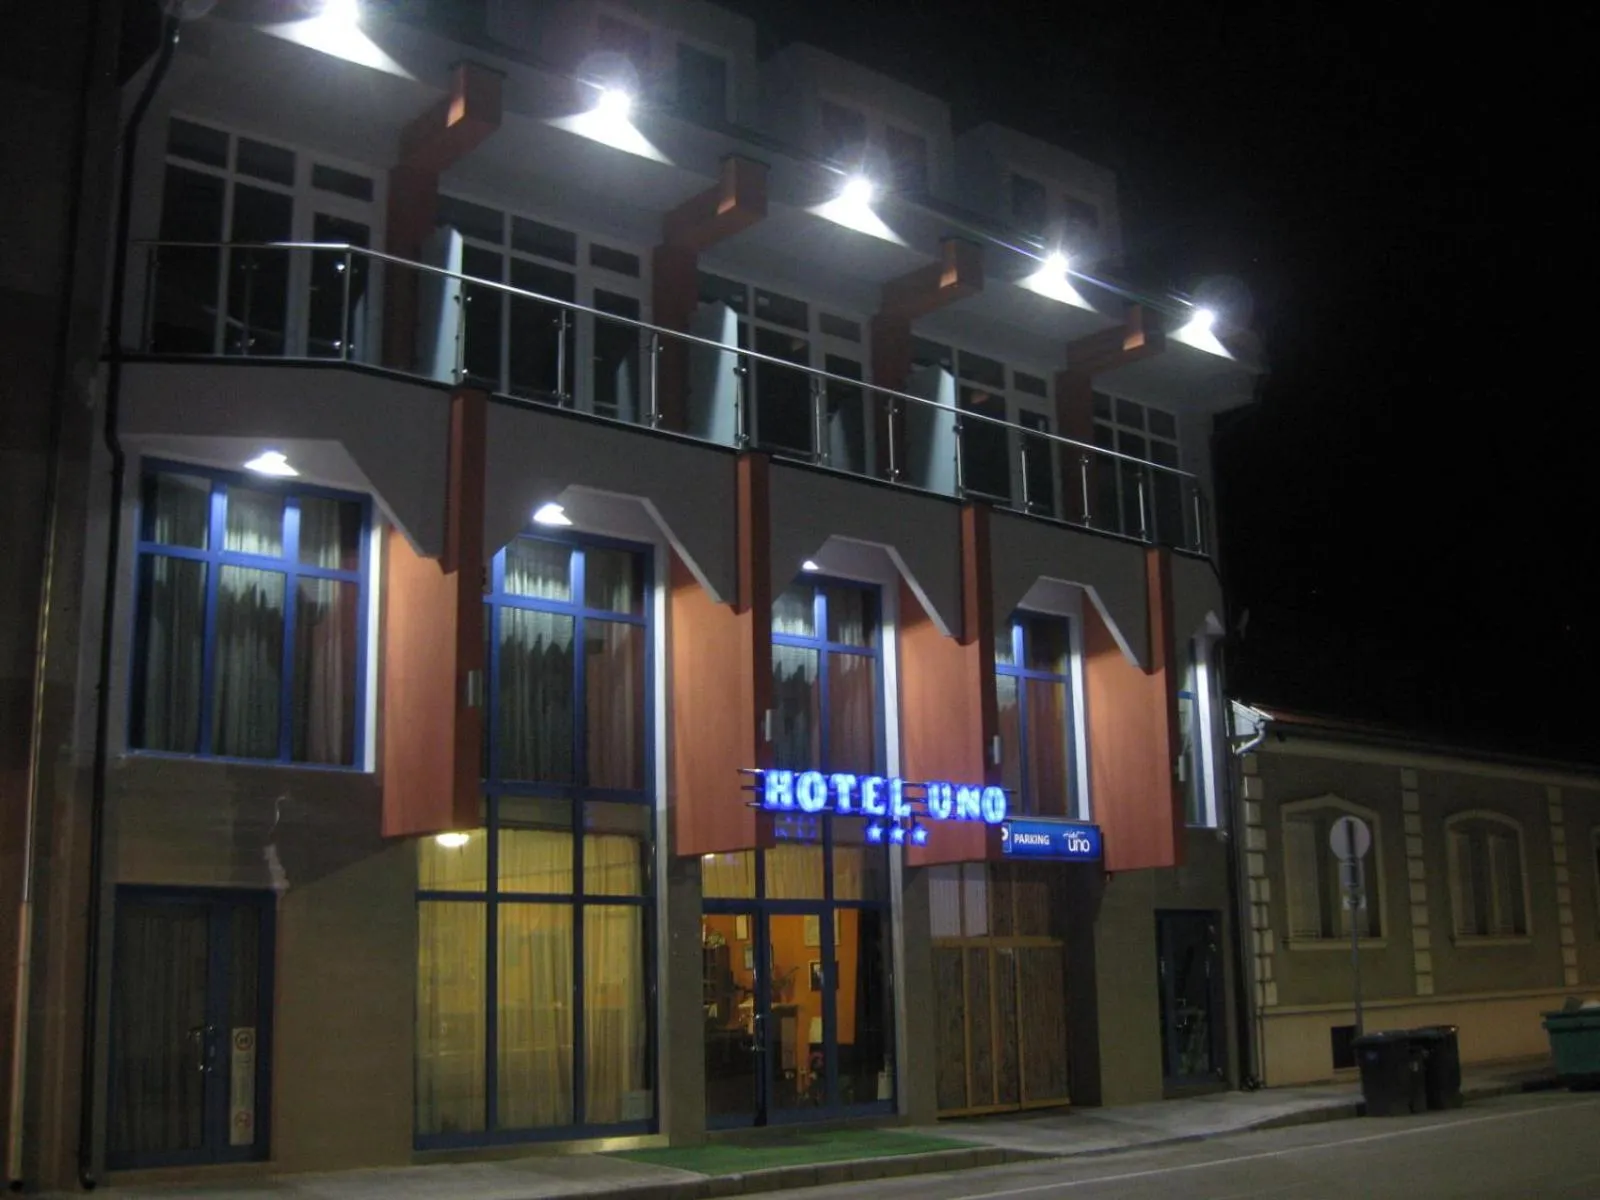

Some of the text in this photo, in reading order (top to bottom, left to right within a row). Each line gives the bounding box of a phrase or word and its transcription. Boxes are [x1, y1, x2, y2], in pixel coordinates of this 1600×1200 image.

[764, 769, 1007, 824] HOTEL UNO
[1013, 833, 1050, 846] PARKING
[1067, 838, 1091, 853] uno
